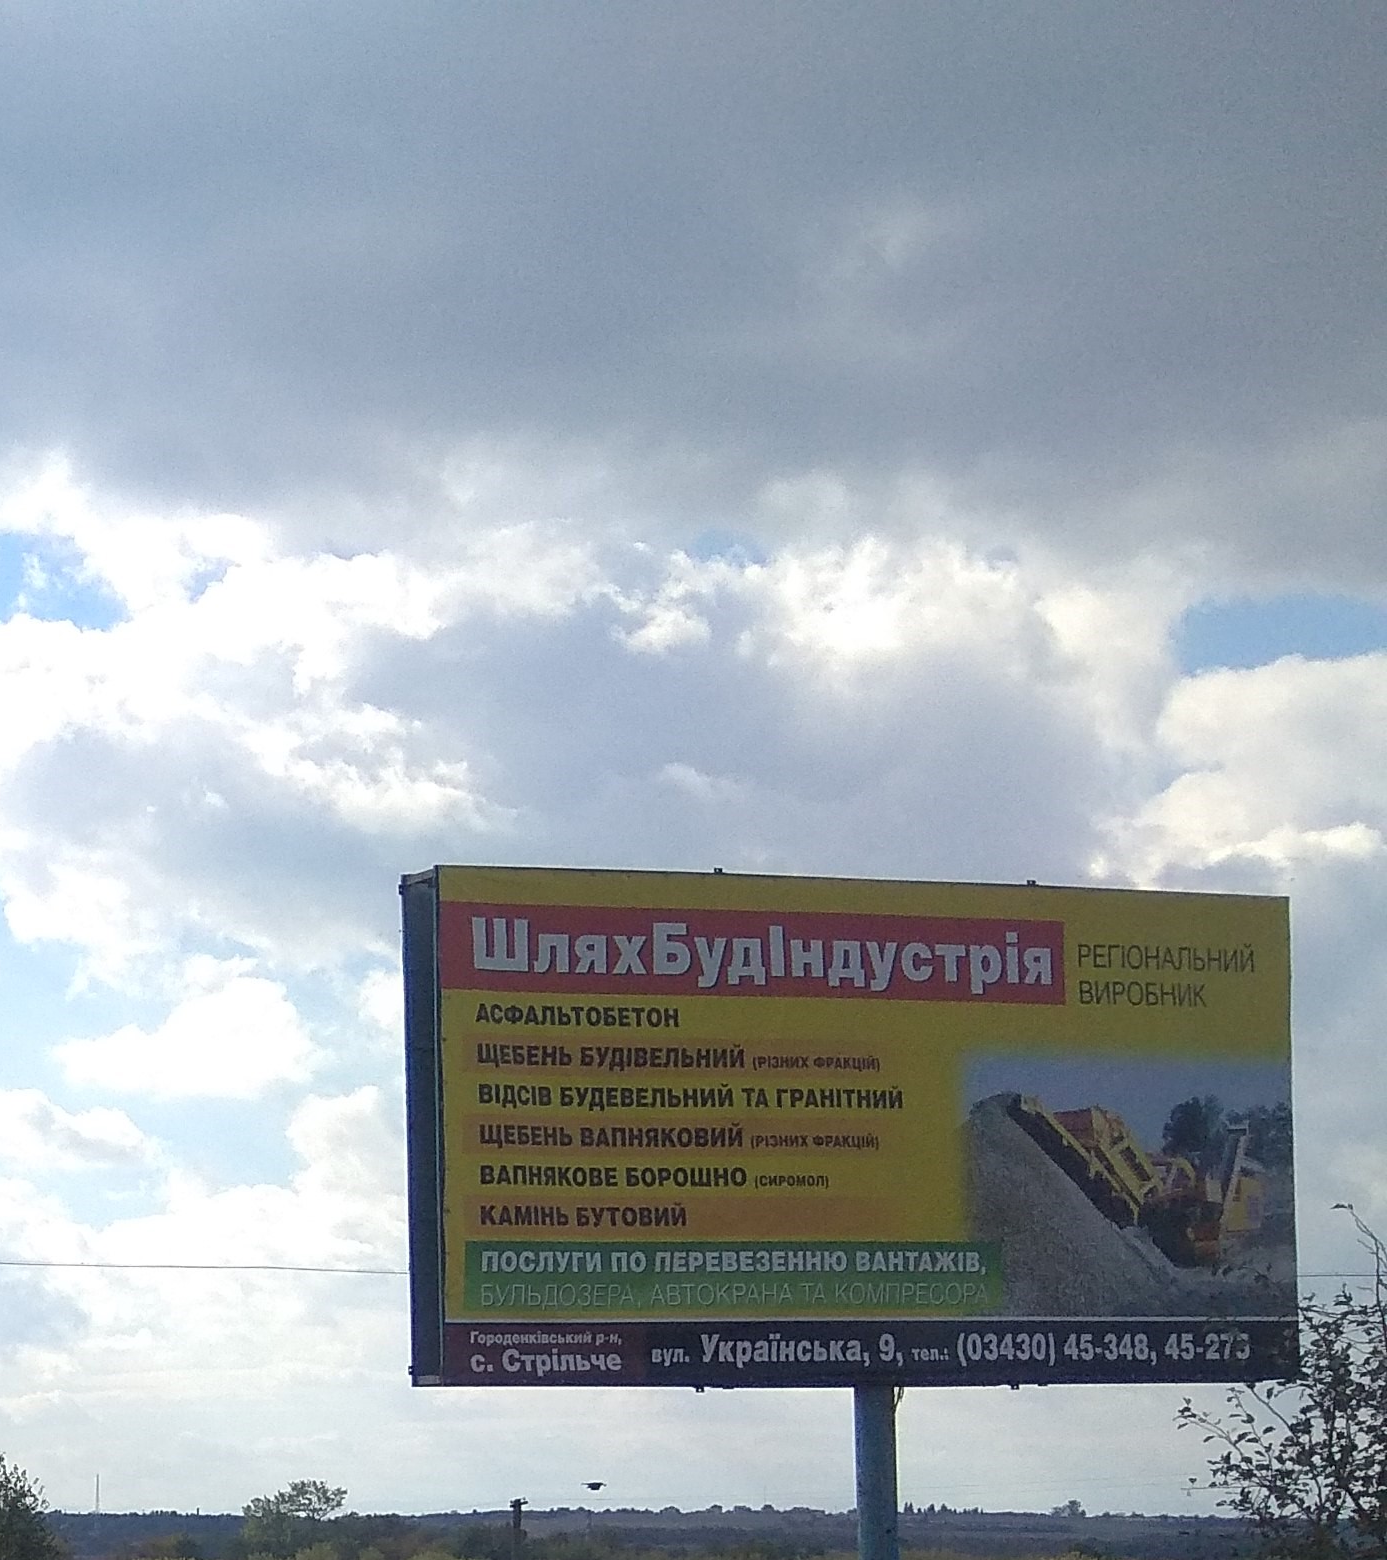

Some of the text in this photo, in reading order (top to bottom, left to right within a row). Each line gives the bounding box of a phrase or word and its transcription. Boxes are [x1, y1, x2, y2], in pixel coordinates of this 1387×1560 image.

[472, 916, 1053, 994] ШляхБудІндустрія
[1077, 943, 1255, 974] РЕГІОНАЛЬНИЙ
[1079, 981, 1207, 1007] ВИРОБНИК
[475, 1003, 680, 1028] АСФАЛЬТОБЕТОН
[477, 1043, 880, 1072] ЩЕБЕНЬ БУДІВЕЛЬНИЙ (РІЗНИХ ФРАКЦІЙ)
[478, 1083, 904, 1112] ВІДСІВ БУДЕВЕЛЬНИЙ ТА ГРАНІТНИЙ
[479, 1122, 880, 1150] ЩЕБЕНЬ ВАПНЯКОВИЙ (РІЗНИХ ФРАКЦІЙ)
[480, 1165, 830, 1190] ВАПНЯКОВЕ БОРОШНО (СИРОМОЛ)
[480, 1203, 688, 1227] КАМІНЬ БУТОВИЙ
[481, 1250, 987, 1275] ПОСЛУГИ ПО ПЕРЕВЕЗЕННЮ ВАНТАЖІВ,
[480, 1282, 988, 1310] БУЛЬДОЗЕРА, АВТОКРАНА ТА КОМПРЕСОРА
[470, 1330, 622, 1347] Городенківський р-н,
[651, 1347, 690, 1367] вул.
[700, 1333, 870, 1368] Українська,
[879, 1333, 904, 1366] 9,
[957, 1332, 1056, 1367] (03430)
[1064, 1333, 1158, 1366] 45-348,
[470, 1348, 622, 1376] с. Стрільче
